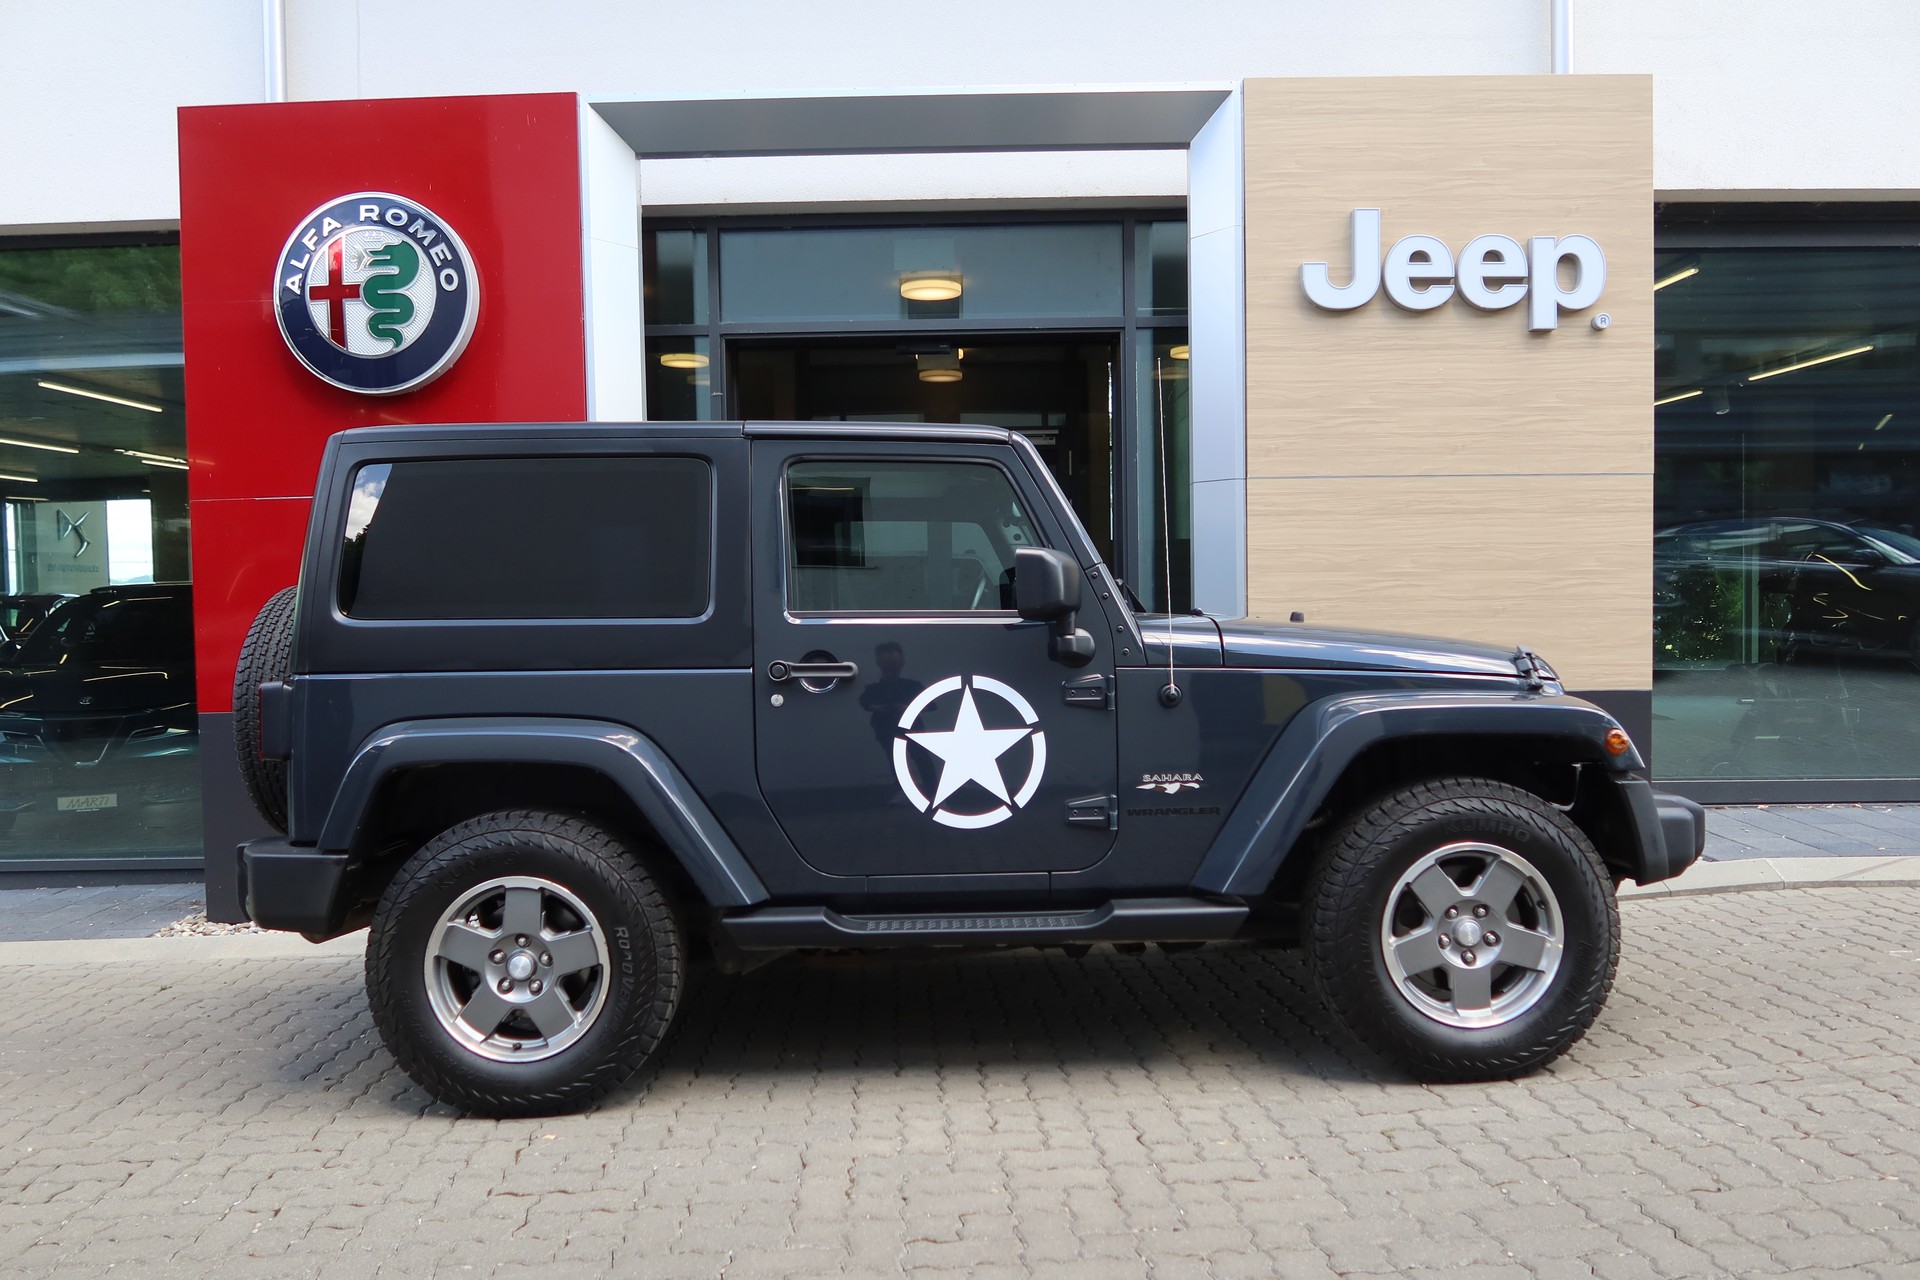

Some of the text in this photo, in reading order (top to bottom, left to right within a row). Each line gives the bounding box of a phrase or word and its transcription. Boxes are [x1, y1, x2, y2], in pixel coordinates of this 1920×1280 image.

[286, 204, 459, 295] ALFA ROMEO
[1300, 208, 1606, 331] Jeep
[1142, 773, 1204, 782] SAHARA
[1126, 806, 1222, 817] WRANGLER
